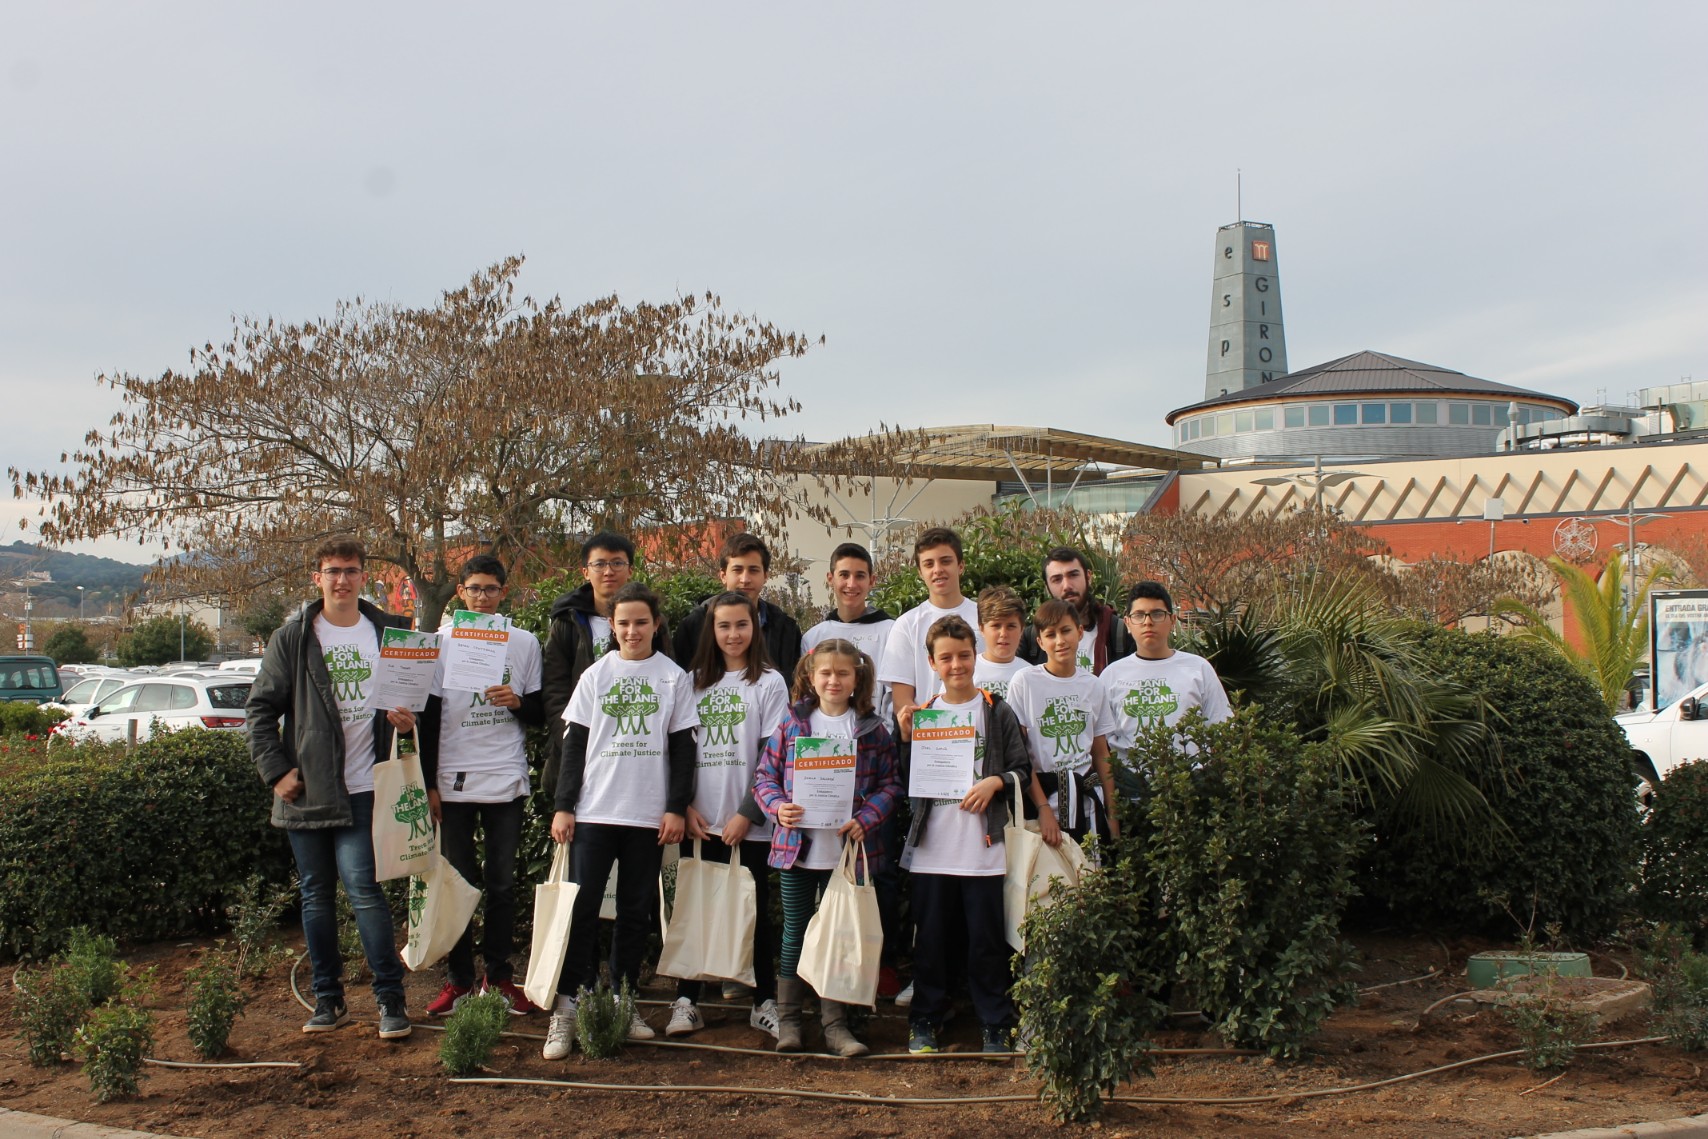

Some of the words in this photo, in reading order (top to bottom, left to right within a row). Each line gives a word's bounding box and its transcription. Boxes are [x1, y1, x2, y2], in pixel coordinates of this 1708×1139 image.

[454, 630, 505, 640] CERTIFICADO
[325, 643, 358, 654] PLANT
[333, 652, 354, 661] FOR
[336, 660, 373, 670] PLANET
[613, 676, 649, 686] PLANT
[1139, 678, 1166, 687] LANT
[619, 685, 641, 694] FOR
[705, 687, 739, 696] PLANT
[1139, 687, 1160, 696] FOR
[600, 695, 619, 704] THE
[622, 694, 661, 704] PLANET
[709, 696, 731, 705] FOR
[1046, 695, 1078, 707] PLANT
[1122, 696, 1139, 706] THE
[1142, 693, 1180, 705] PLANET
[711, 703, 749, 714] PLANET
[461, 719, 491, 727] Climate
[1037, 716, 1056, 727] THE
[916, 729, 971, 738] CERTIFICADO
[633, 750, 661, 758] Justice
[724, 759, 746, 767] Justice
[798, 758, 852, 767] CERTIFICADO
[400, 851, 427, 861] Climate
